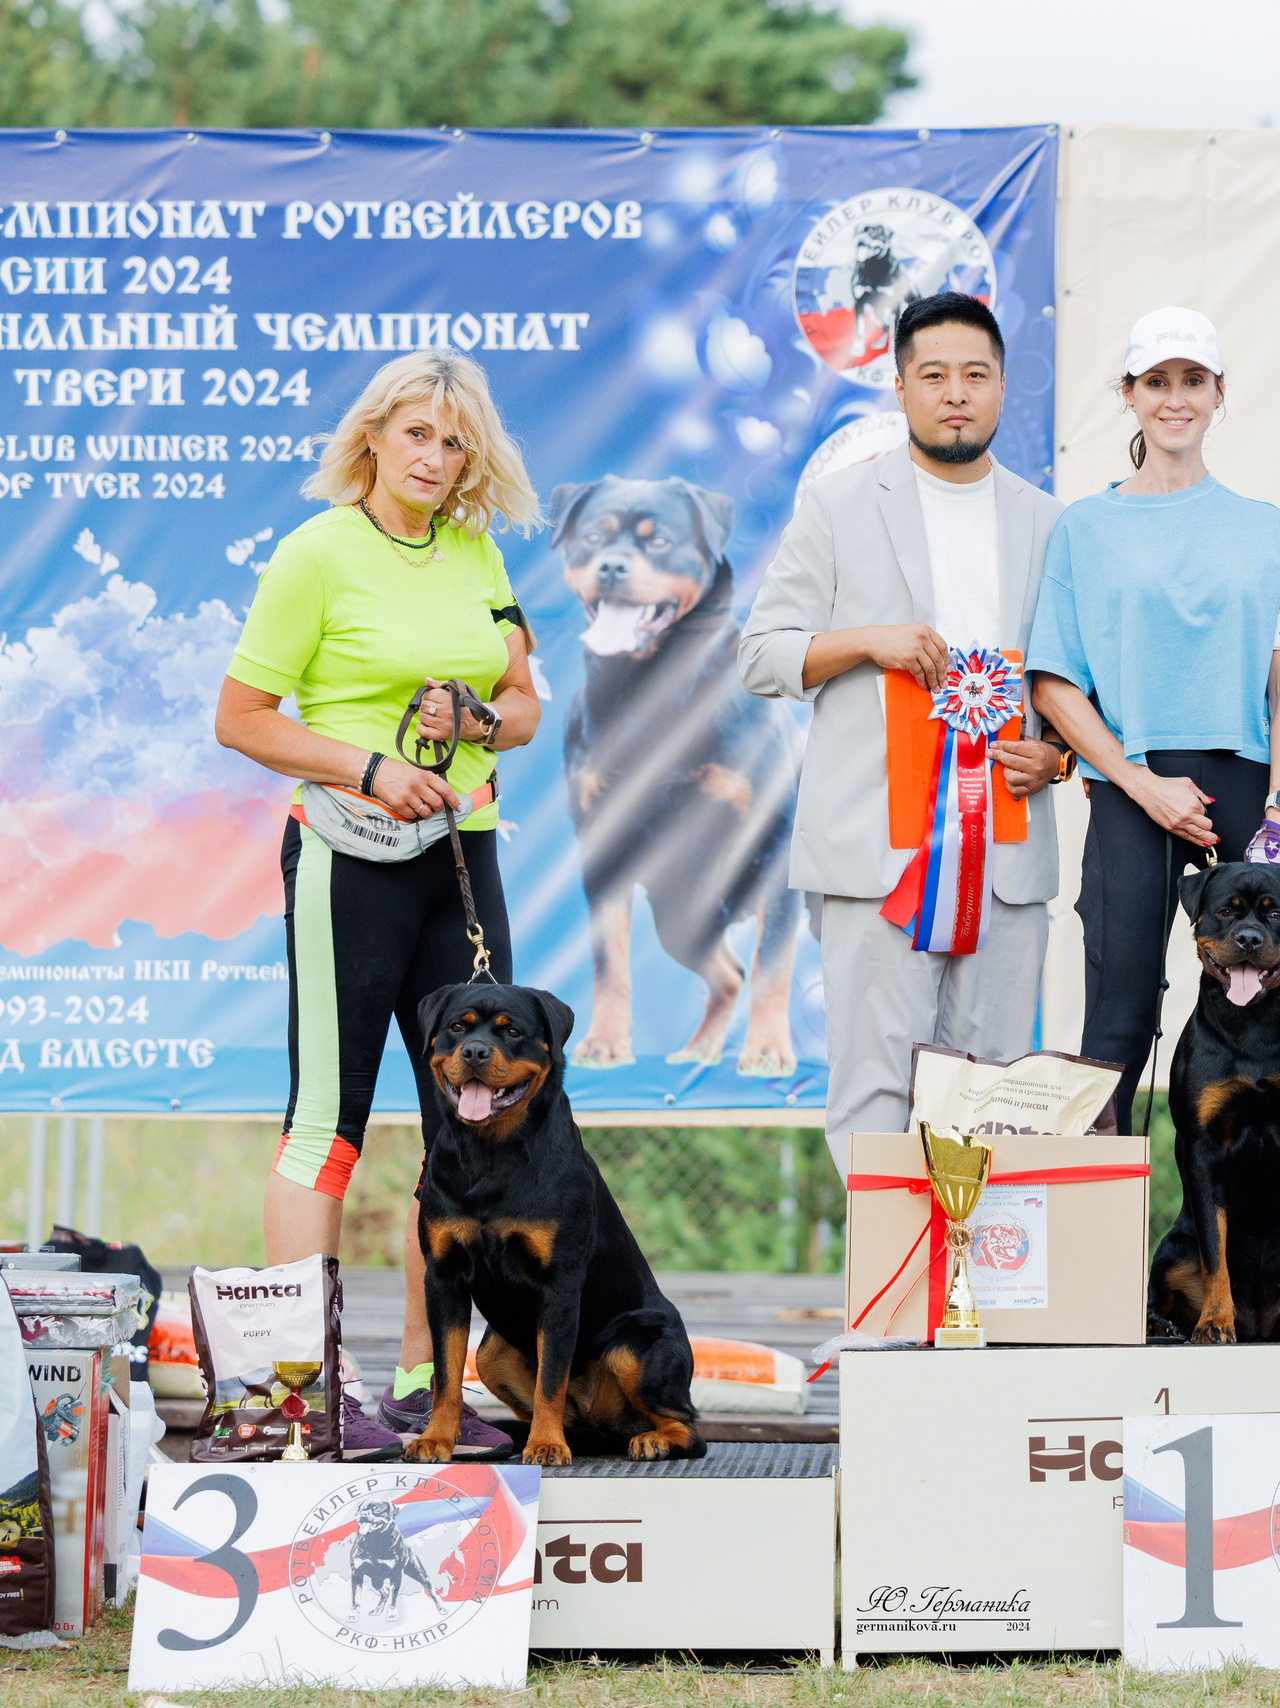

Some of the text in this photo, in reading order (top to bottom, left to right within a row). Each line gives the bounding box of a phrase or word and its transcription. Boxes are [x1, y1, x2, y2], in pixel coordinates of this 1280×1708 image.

[0, 192, 643, 240] МПИОНАТ РОТВЕЙЛЕРОВ
[888, 195, 953, 226] КЛУБ
[122, 255, 232, 294] 2024
[255, 312, 590, 351] ЧЕМПИОНАТ
[1156, 331, 1197, 345] FILA
[14, 368, 311, 407] ТВЕРИ 2024
[0, 434, 313, 462] LUB WINNER 2024
[45, 472, 142, 499] TVER
[152, 472, 226, 499] 2024
[960, 823, 978, 940] Победитель класса
[134, 960, 191, 982] НКП
[201, 959, 289, 982] Ротвей
[38, 1037, 215, 1069] ВМЕСТЕ
[1020, 1101, 1049, 1111] рисом
[216, 1283, 302, 1301] Hanta
[243, 1330, 272, 1338] PUPPY
[293, 1475, 497, 1605] РОТВЕЙЛЕР КЛУБ РОССИИ
[1152, 1426, 1243, 1628] 1
[157, 1473, 260, 1651] 3
[335, 1622, 449, 1650] РКФ-НКПР
